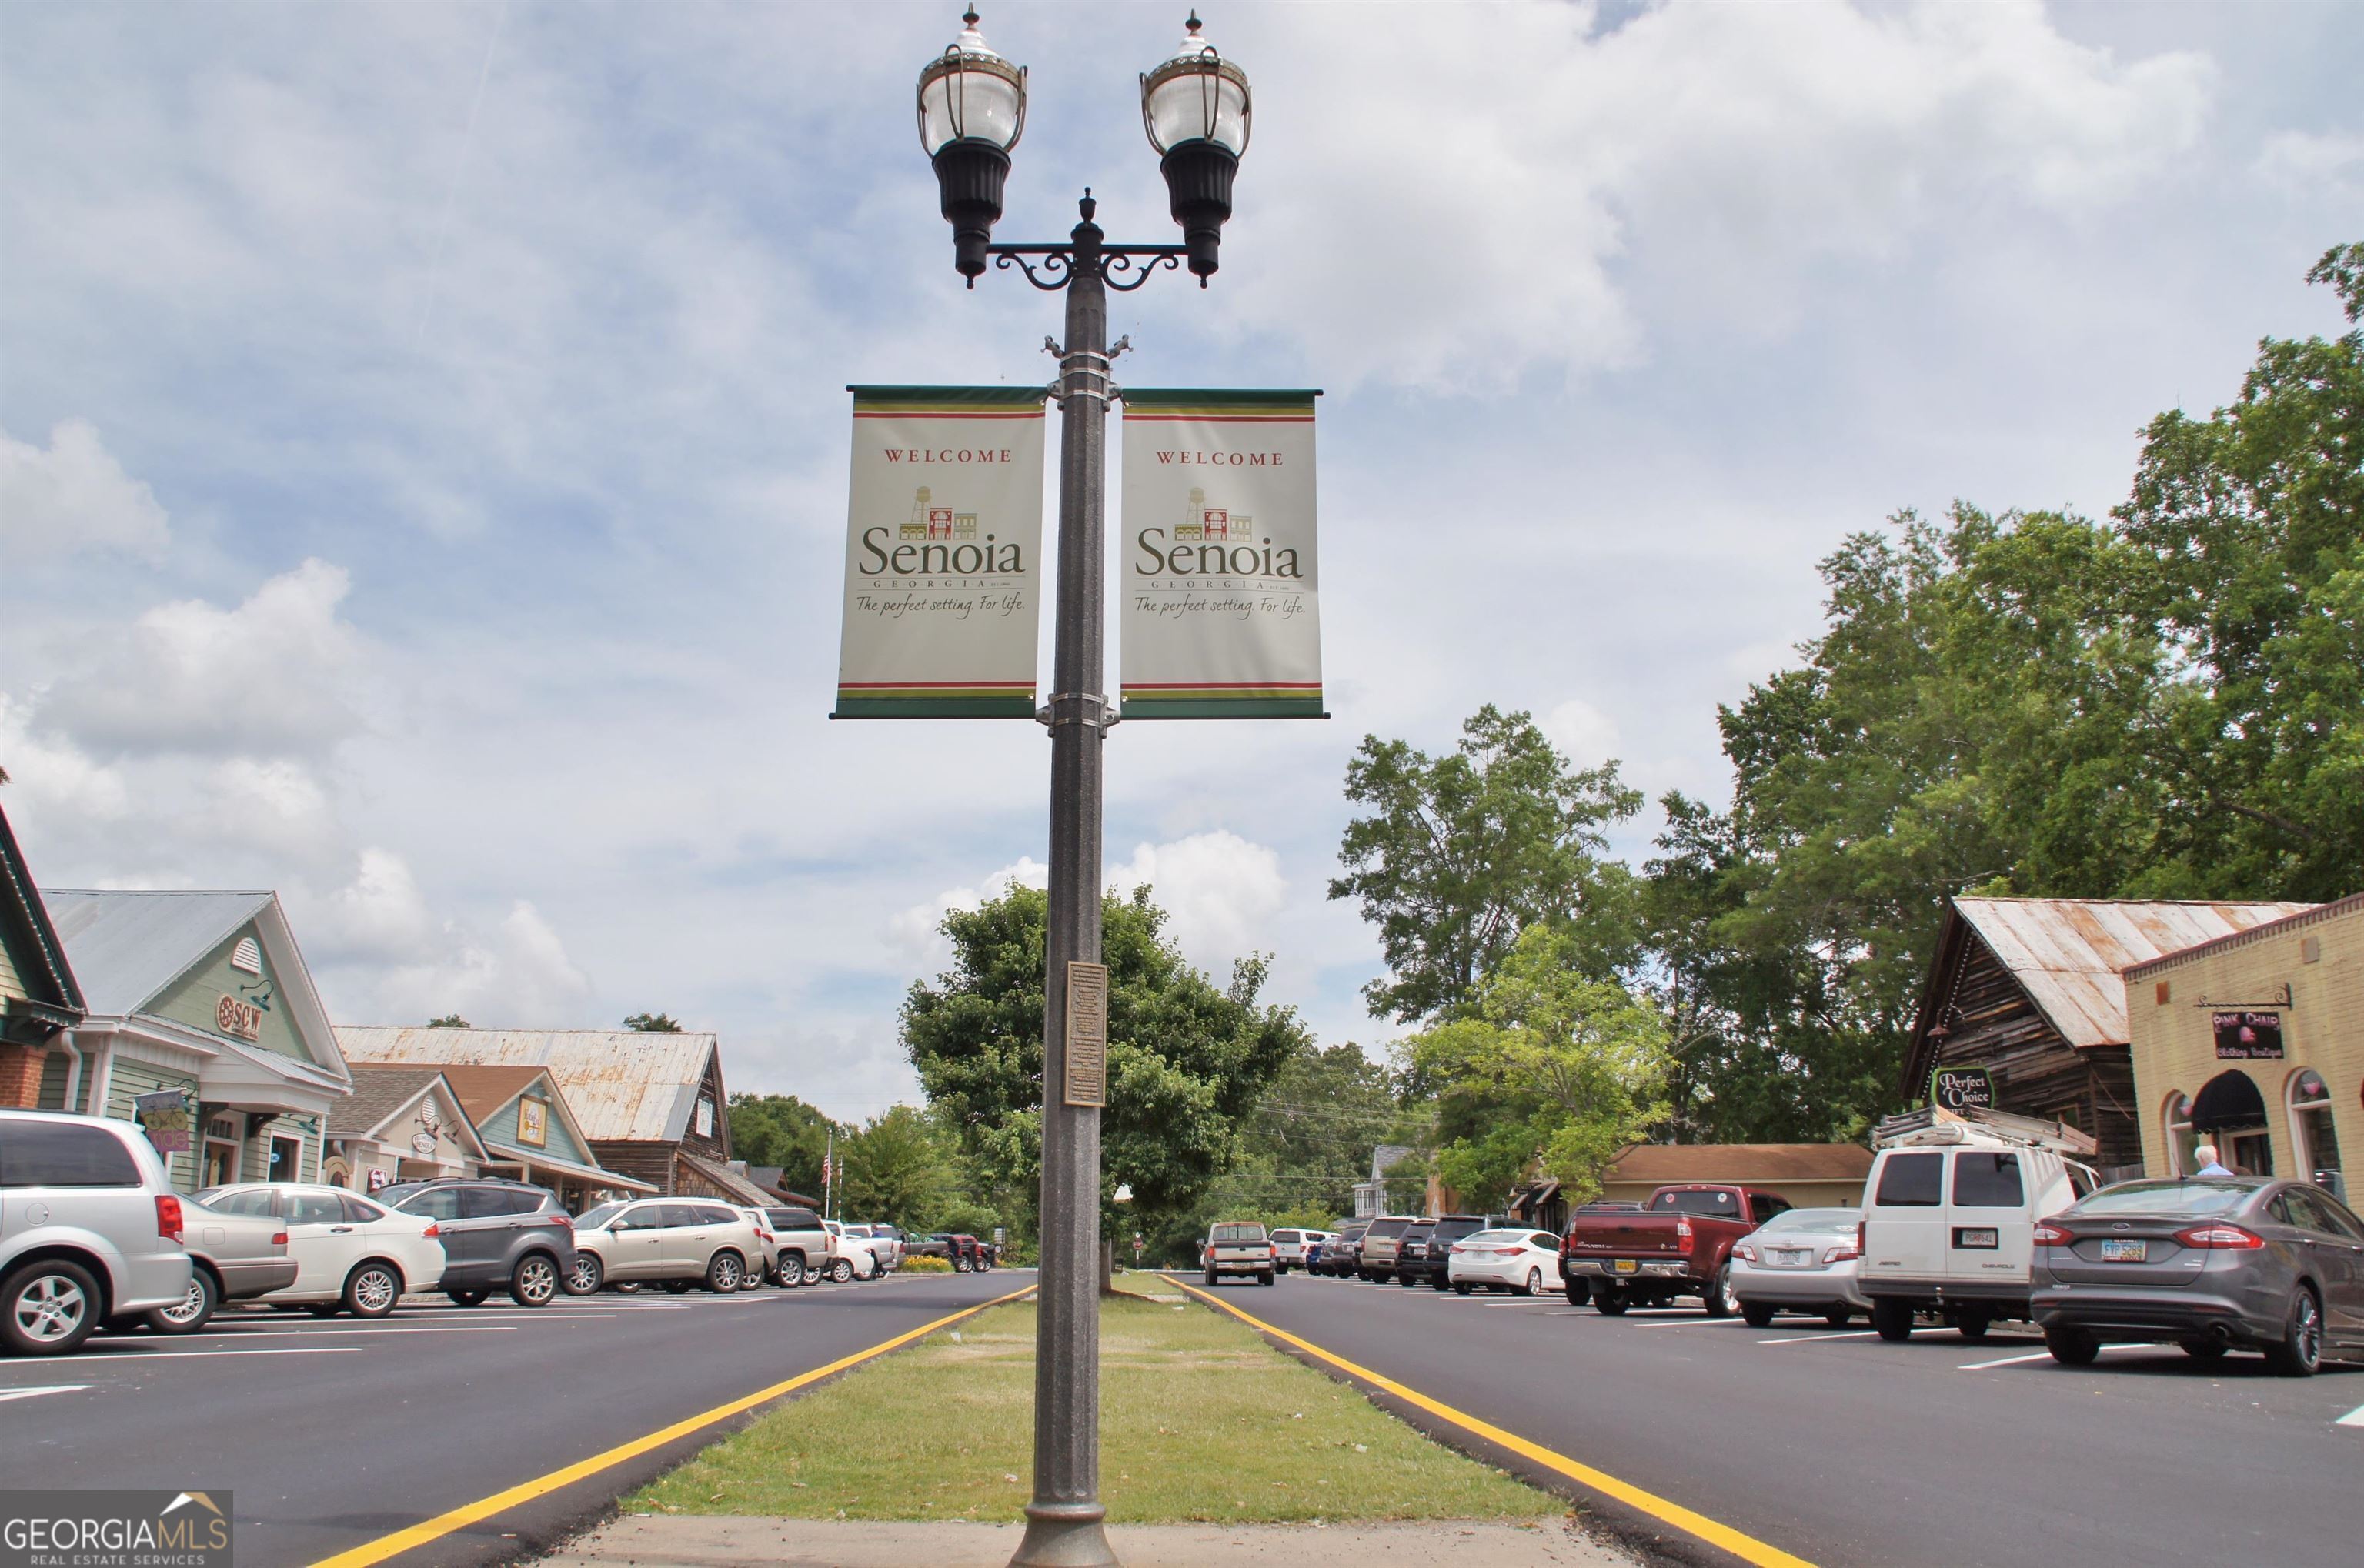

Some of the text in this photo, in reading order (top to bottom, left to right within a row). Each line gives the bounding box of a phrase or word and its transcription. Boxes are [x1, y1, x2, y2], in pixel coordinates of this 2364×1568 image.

[884, 449, 1011, 463] WELCOME
[1156, 451, 1284, 466] WELCOME
[858, 526, 1026, 575] Senoia
[1135, 528, 1304, 579] Senoia
[873, 579, 984, 588] GEORGIA
[1151, 580, 1264, 589] GEORGIA
[856, 592, 1026, 620] The perfect setting. For life.
[1134, 593, 1306, 620] The perfect setting. For life.
[233, 1003, 262, 1030] SCW
[2213, 1012, 2279, 1028] PINK CHAIR
[2217, 1047, 2282, 1059] Clothing Boutique
[1939, 1073, 1985, 1093] Perfect
[1947, 1088, 1989, 1107] Choice
[2105, 1243, 2142, 1256] FVP 5289
